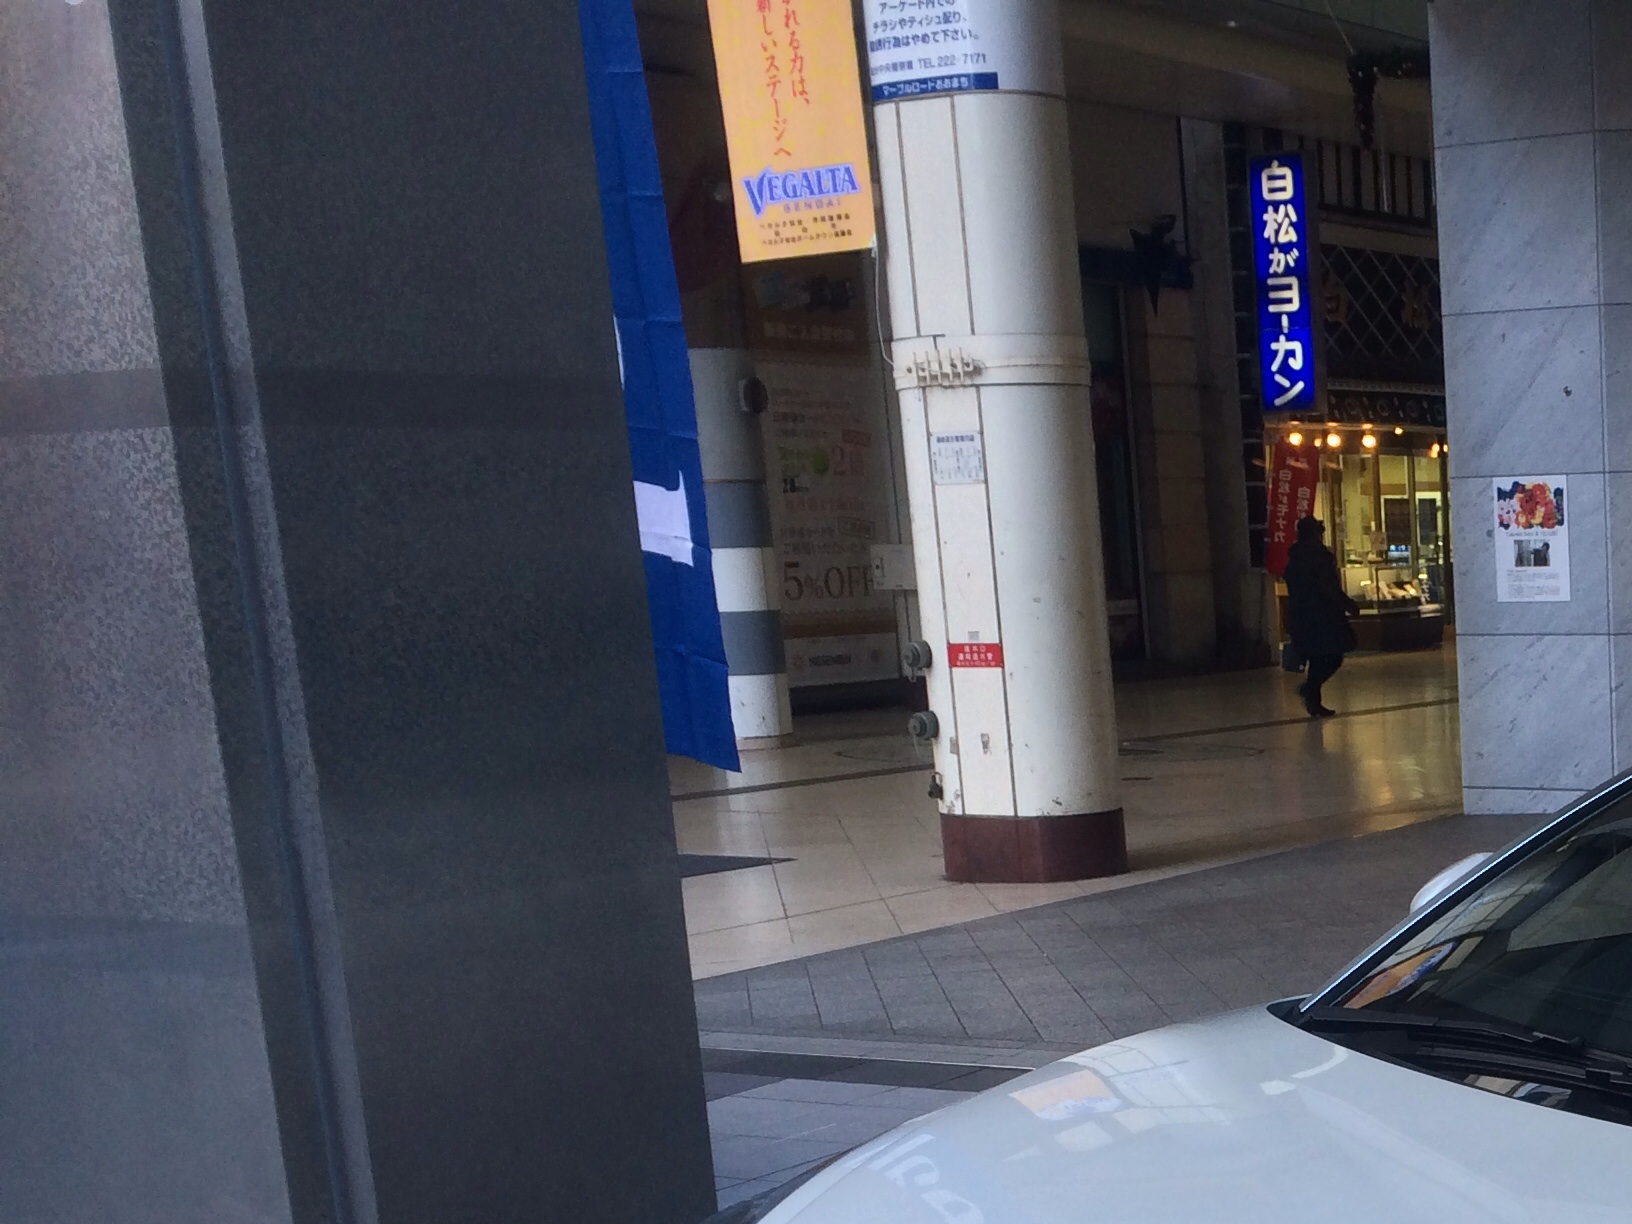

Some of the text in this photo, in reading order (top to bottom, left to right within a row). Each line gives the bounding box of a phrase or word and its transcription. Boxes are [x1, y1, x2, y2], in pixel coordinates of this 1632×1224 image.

[781, 0, 810, 104] れる力は、
[742, 164, 860, 217] VEGALTA
[1260, 159, 1305, 407] 白松がヨーカン
